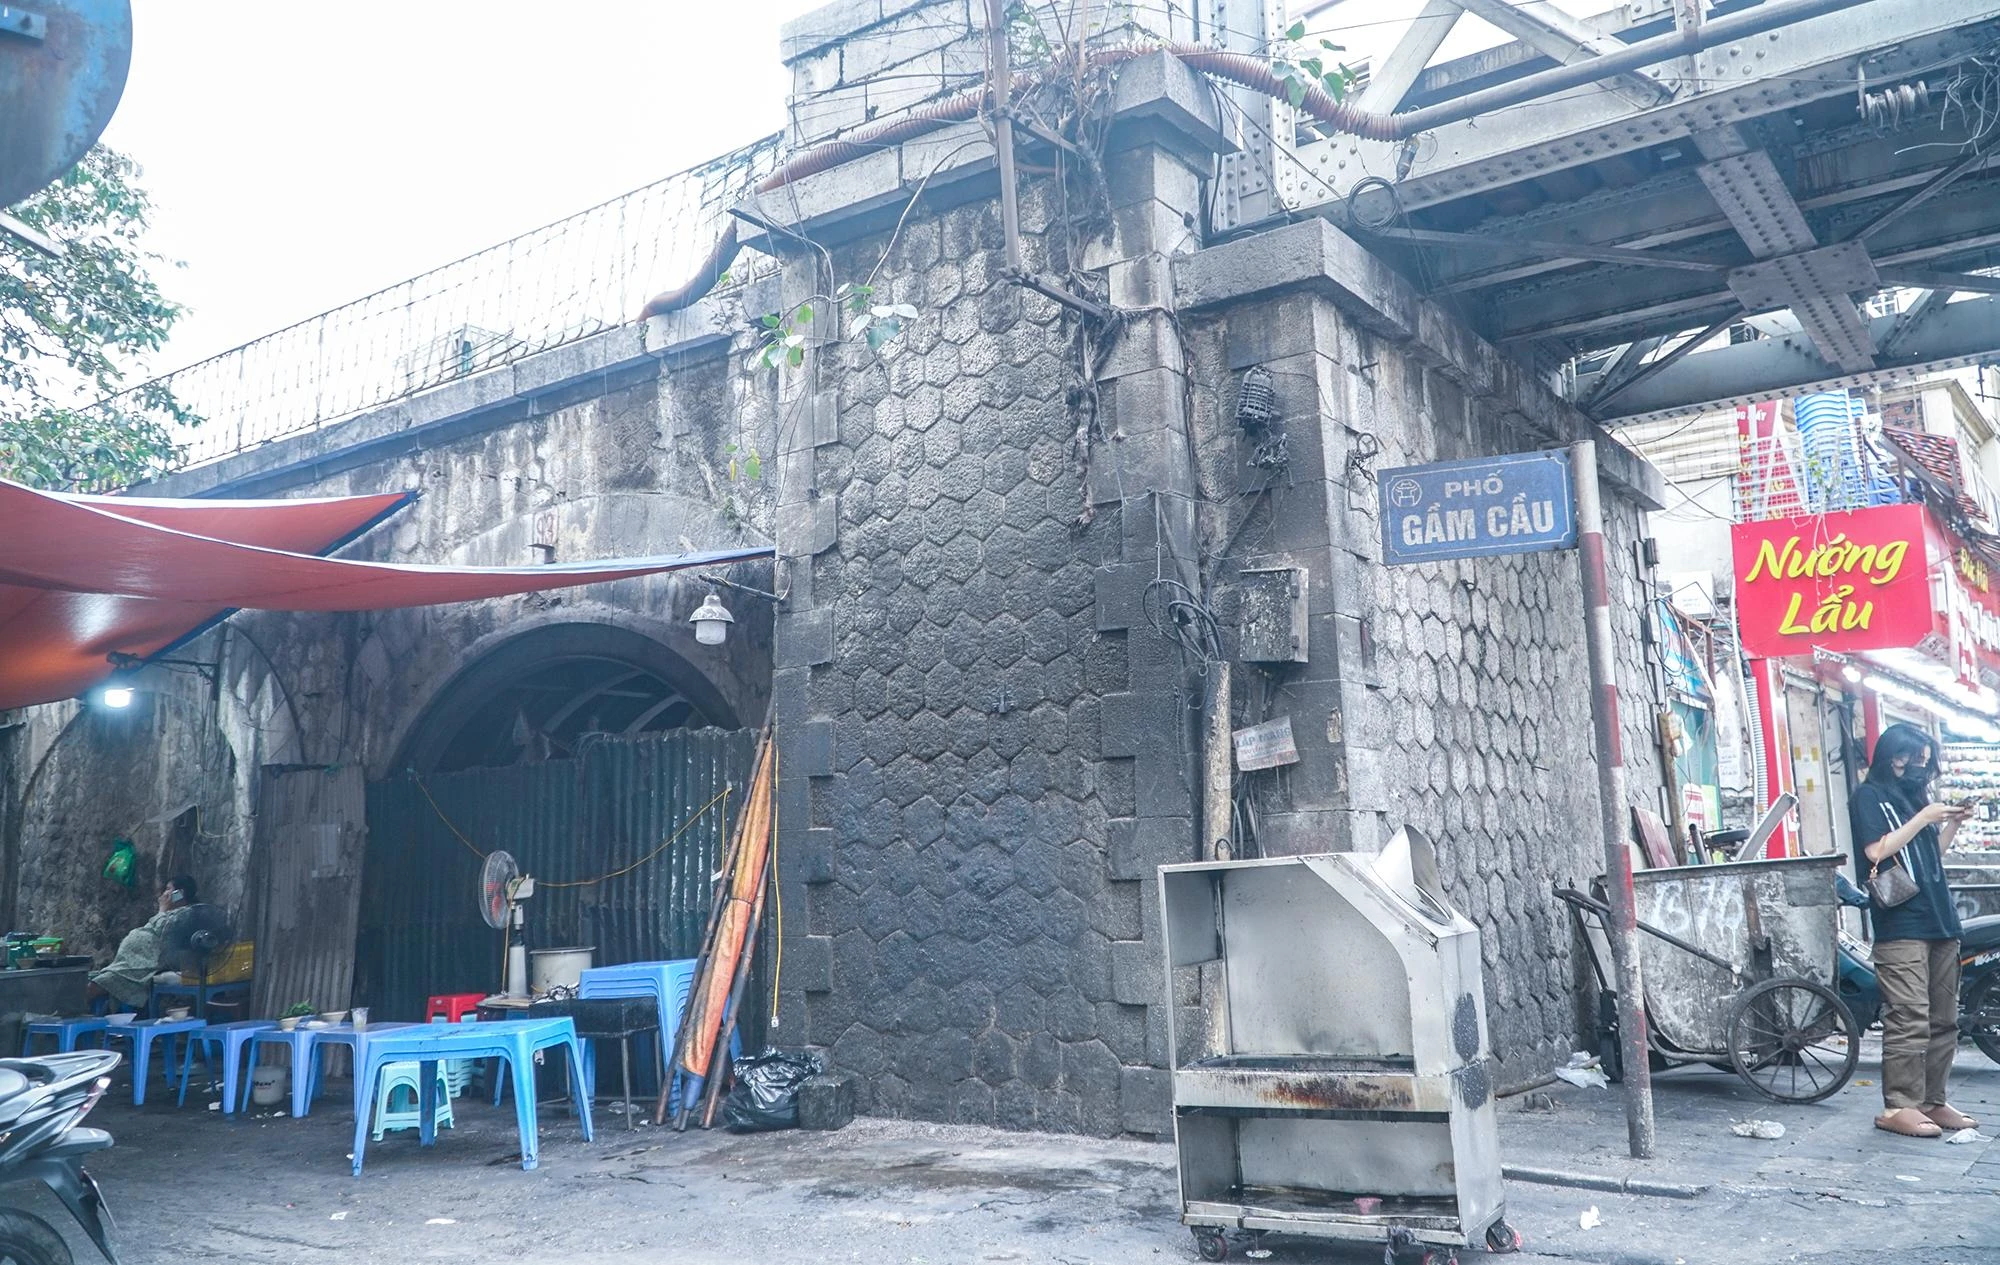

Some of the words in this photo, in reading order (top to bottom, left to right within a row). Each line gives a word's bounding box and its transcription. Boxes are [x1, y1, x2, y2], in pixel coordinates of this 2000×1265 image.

[1444, 469, 1504, 499] PHỐ
[1402, 502, 1476, 546] GẦM
[1487, 492, 1555, 537] CẦU
[1745, 533, 1909, 585] Nướng
[1778, 585, 1873, 634] Lẩu
